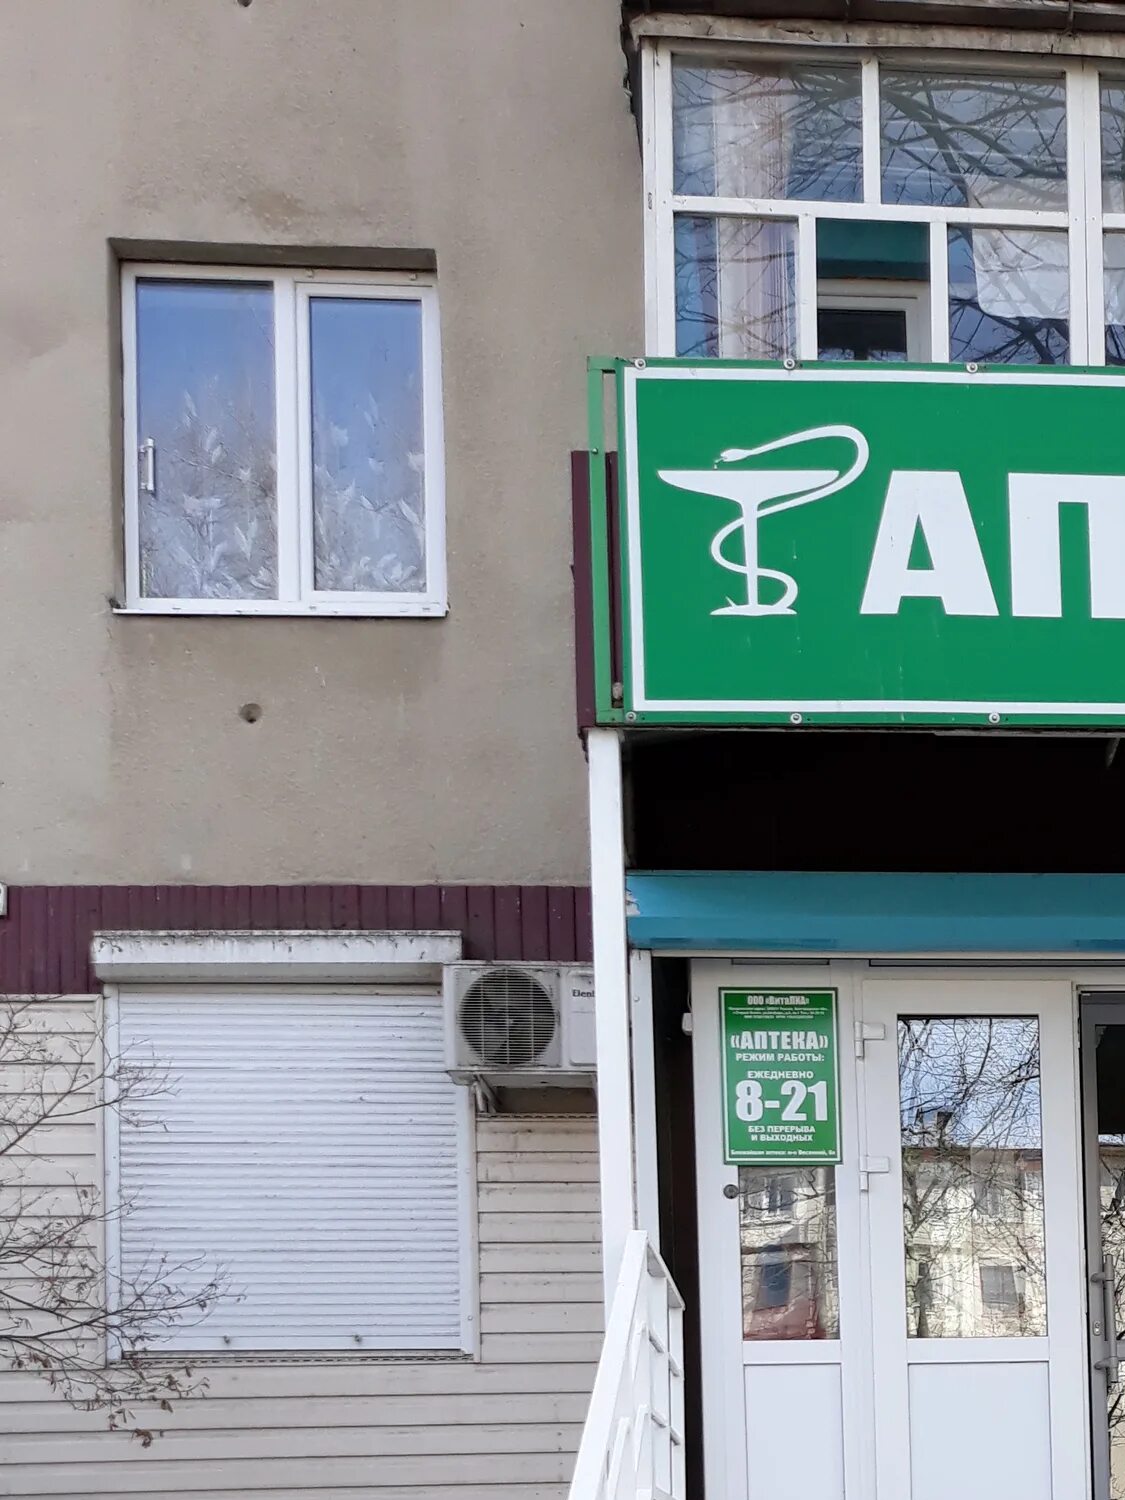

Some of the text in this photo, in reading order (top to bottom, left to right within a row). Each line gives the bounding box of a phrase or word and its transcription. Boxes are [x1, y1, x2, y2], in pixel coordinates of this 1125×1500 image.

[730, 1031, 828, 1050] «АПТЕКА»
[735, 1053, 825, 1062] РЕЖИМ РАБОТЫ:
[747, 1070, 814, 1080] ЕЖЕДНЕВНО
[735, 1080, 828, 1121] 8-21
[747, 1125, 816, 1133] БЕЗ ПЕРЕРЫВА
[759, 1134, 813, 1142] ВЫХОДНЫХ
